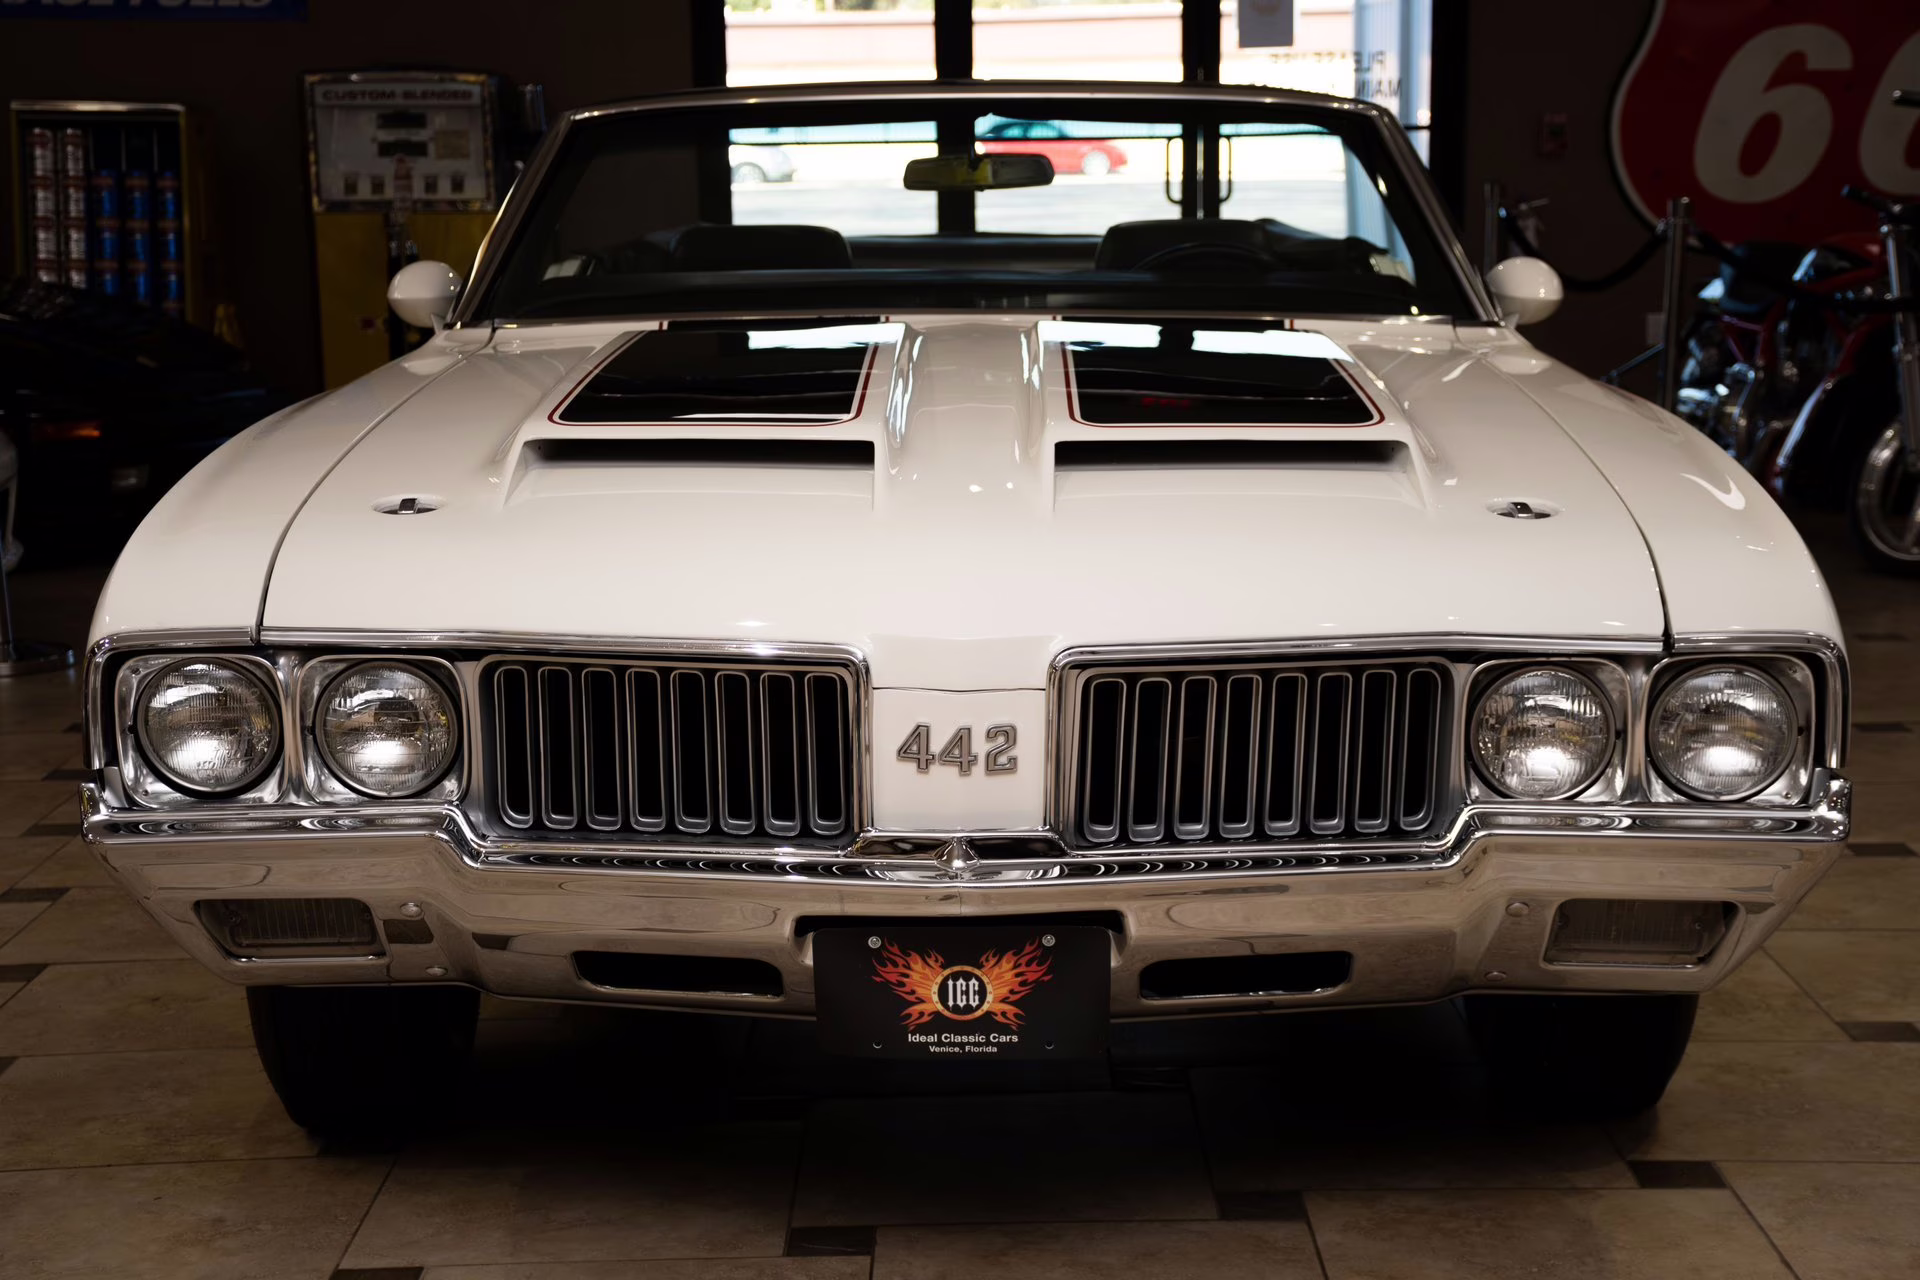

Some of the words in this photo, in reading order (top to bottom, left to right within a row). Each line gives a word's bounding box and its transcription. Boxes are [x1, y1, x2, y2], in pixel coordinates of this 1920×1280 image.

[323, 89, 395, 101] CUSTOM
[897, 722, 1018, 776] 442
[908, 1032, 938, 1043] Ideal
[942, 1032, 986, 1043] Classic
[990, 1032, 1019, 1043] Cars
[929, 1045, 963, 1054] Venice,
[965, 1045, 998, 1053] Florida
